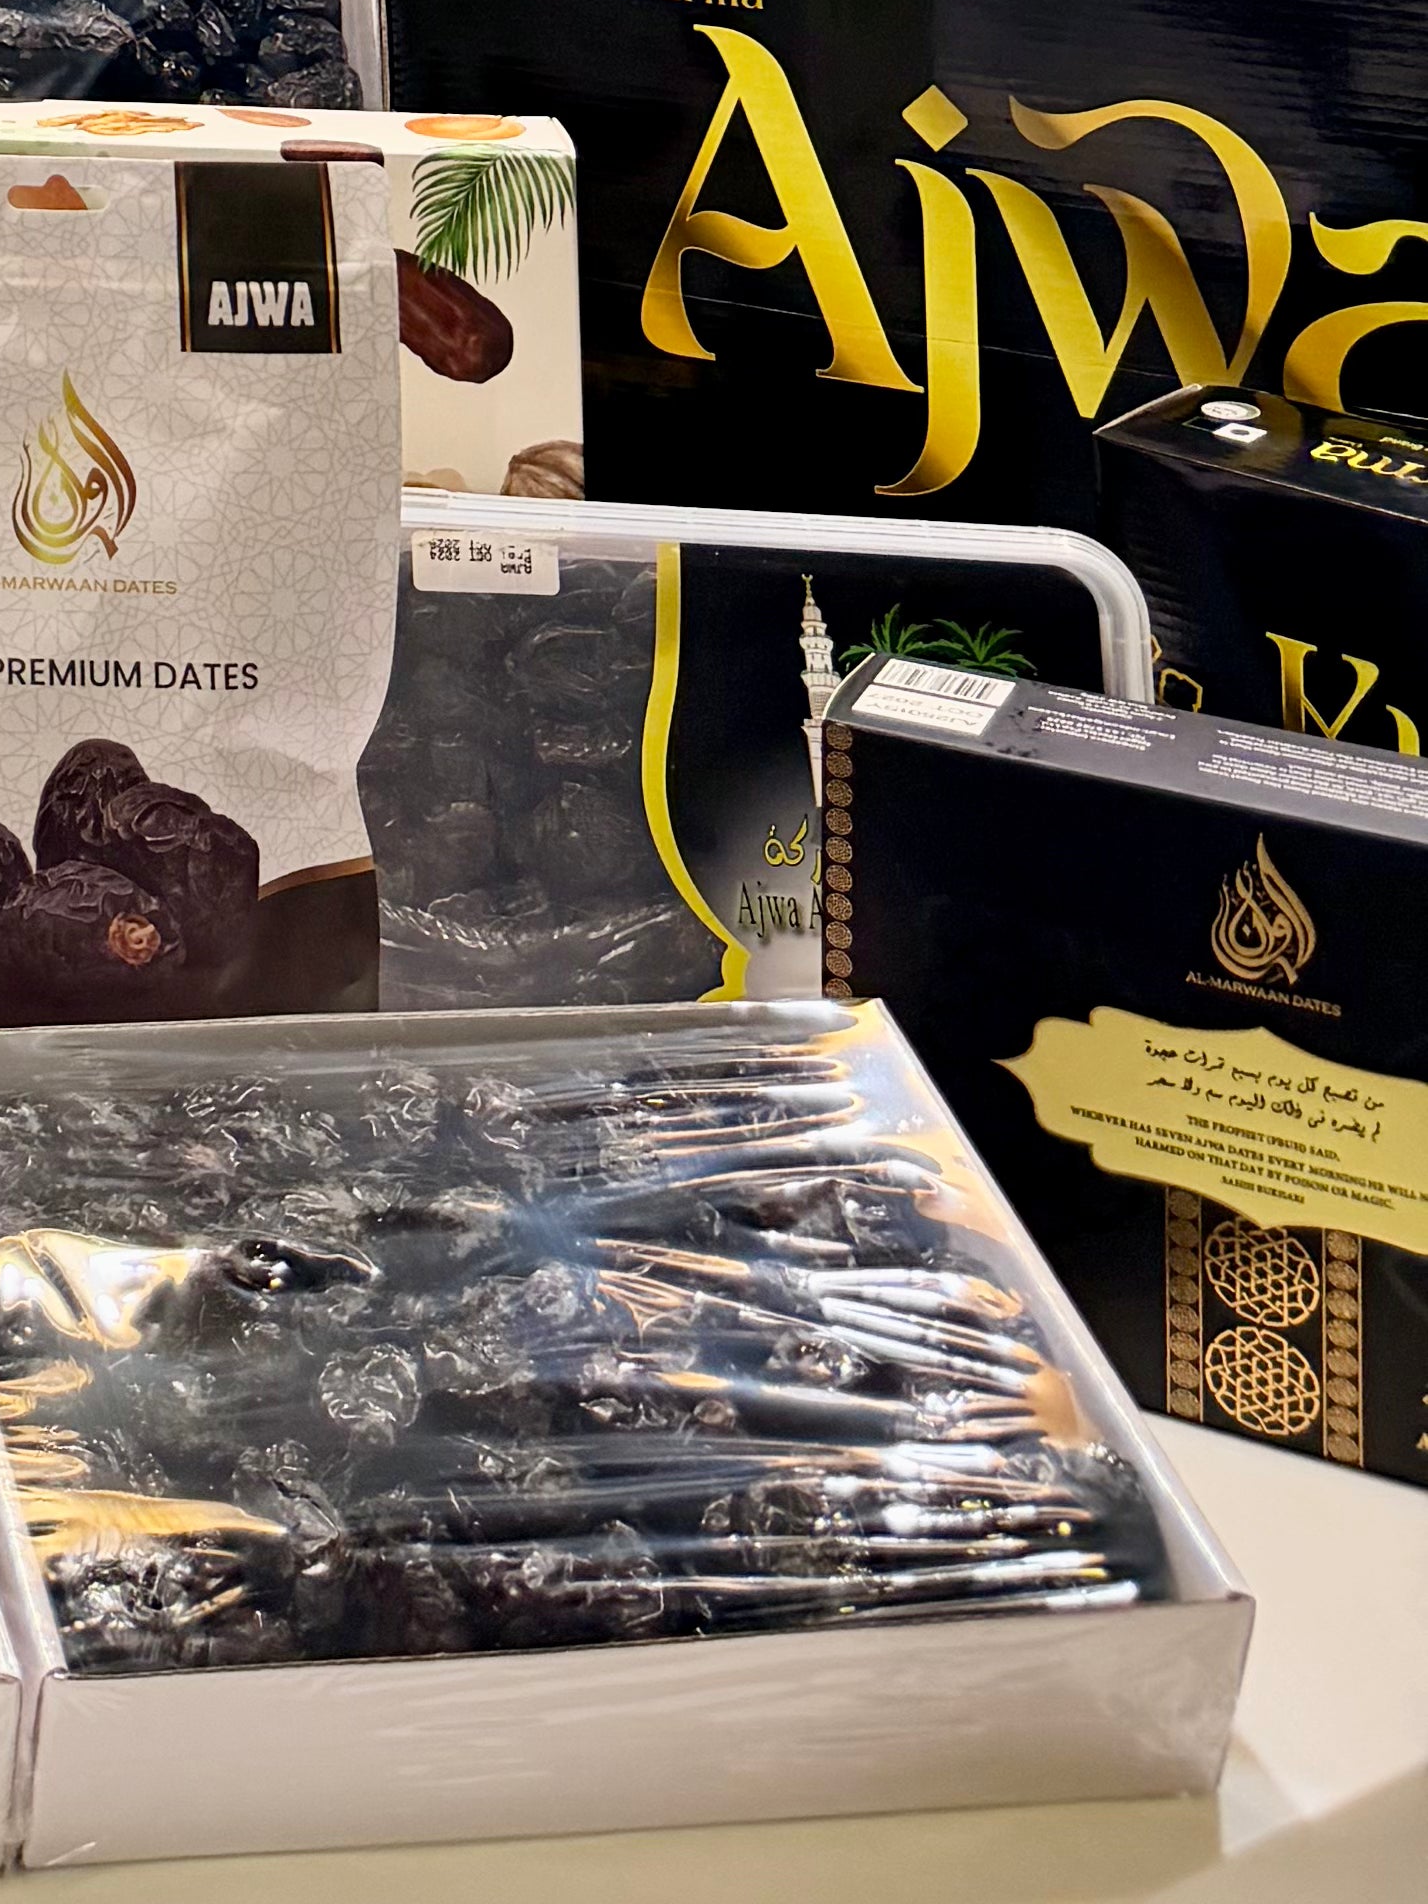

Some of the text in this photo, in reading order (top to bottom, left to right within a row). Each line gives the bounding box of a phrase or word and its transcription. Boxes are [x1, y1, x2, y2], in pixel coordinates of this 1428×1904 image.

[640, 24, 1428, 495] Ajwa
[207, 281, 315, 329] AJWA
[112, 578, 178, 596] DATES
[154, 661, 259, 691] DATES
[738, 881, 801, 938] Ajwa
[1185, 970, 1343, 1018] AL-MARWAAN DATES
[1185, 1114, 1211, 1129] THE
[1211, 1118, 1266, 1142] PROPHET
[1070, 1104, 1128, 1129] WHOEVER
[1129, 1118, 1153, 1134] HAS
[1155, 1126, 1194, 1144] SEVEN
[1194, 1136, 1226, 1153] AJWA
[1227, 1142, 1265, 1162] DATES
[1267, 1153, 1306, 1172] EVERY
[1308, 1163, 1368, 1188] MORNING
[1387, 1183, 1419, 1201] WILL
[1134, 1135, 1186, 1158] HARMED
[1187, 1148, 1207, 1163] ON
[1207, 1152, 1239, 1171] THAT
[1239, 1161, 1265, 1178] DAY
[1266, 1167, 1284, 1182] BY
[1284, 1174, 1330, 1193] POISON
[1330, 1185, 1349, 1199] OR
